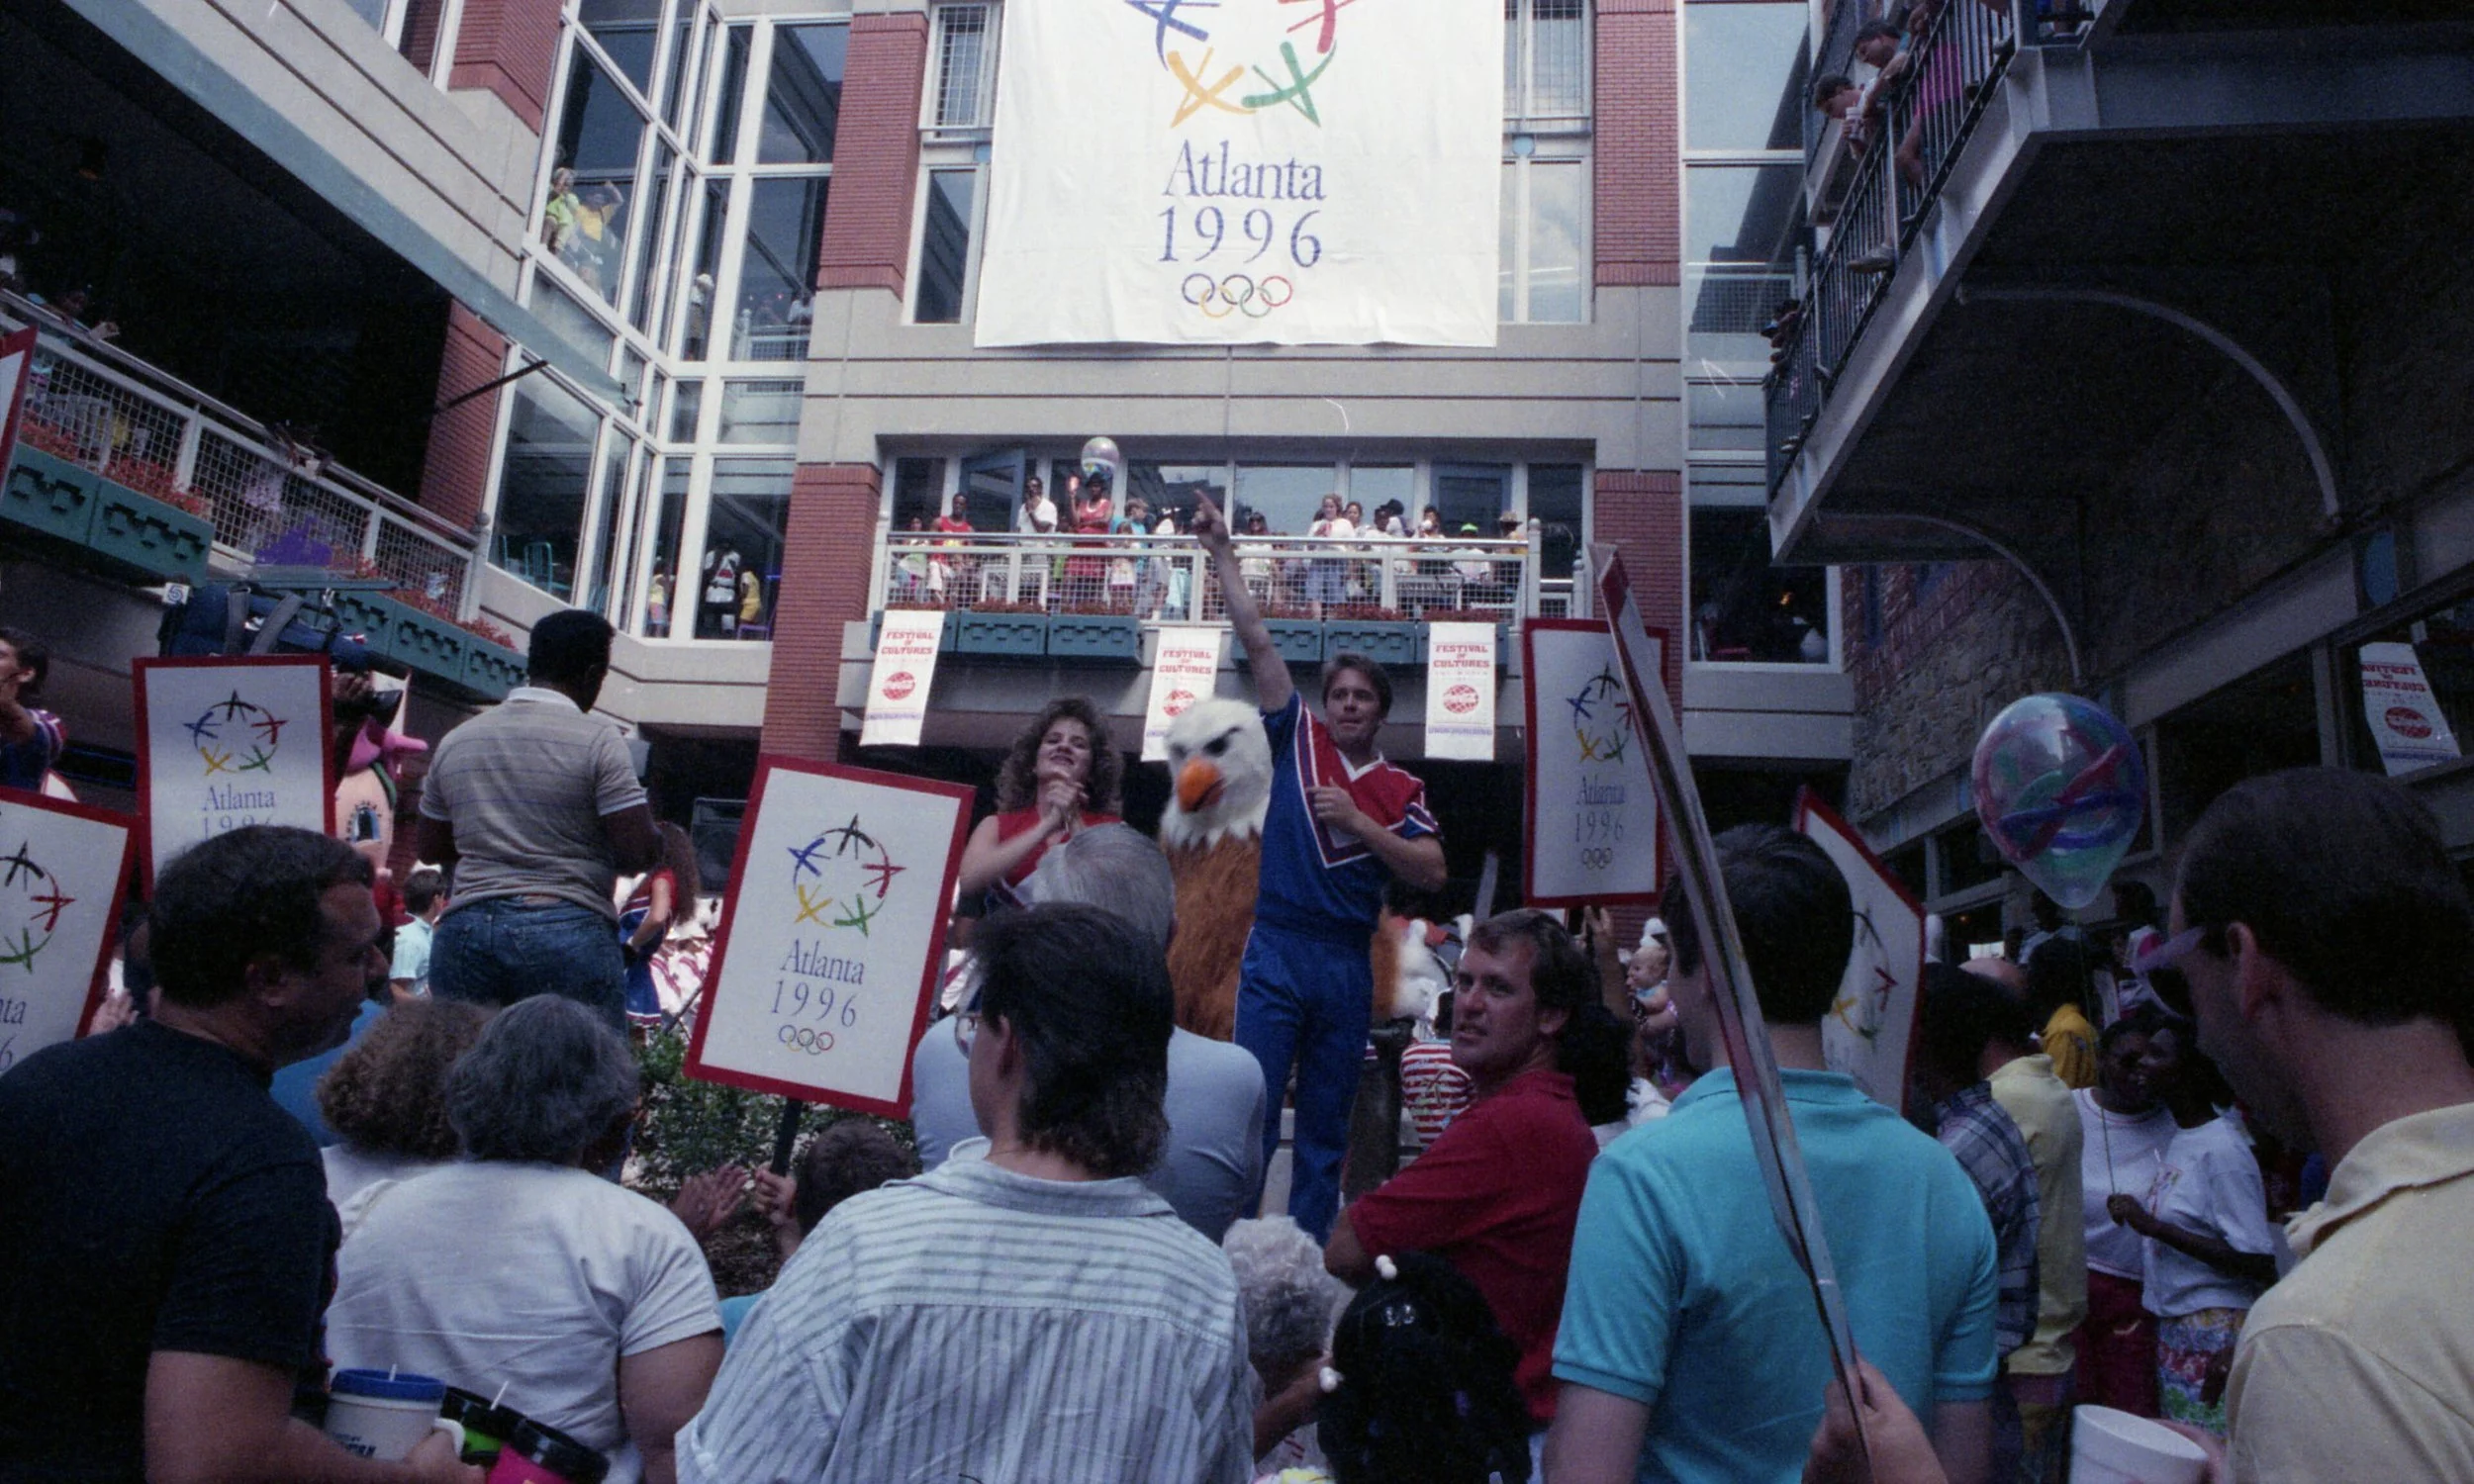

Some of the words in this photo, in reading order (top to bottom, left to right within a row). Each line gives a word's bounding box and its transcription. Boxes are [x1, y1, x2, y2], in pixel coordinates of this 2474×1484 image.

[1161, 139, 1328, 202] Atlanta
[1157, 205, 1323, 268] 1996
[886, 631, 934, 640] FESTIVAL
[1435, 644, 1489, 654] FESTIVAL
[881, 646, 934, 655] CULTURES
[1162, 649, 1212, 659] FESTIVAL
[1433, 659, 1490, 669] CULTURES
[1159, 664, 1212, 675] CULTURES
[202, 783, 275, 811] Atlanta
[1575, 773, 1626, 805] Atlanta
[1575, 811, 1624, 843] 1996
[779, 938, 865, 985] Atlanta
[771, 978, 857, 1028] 1996
